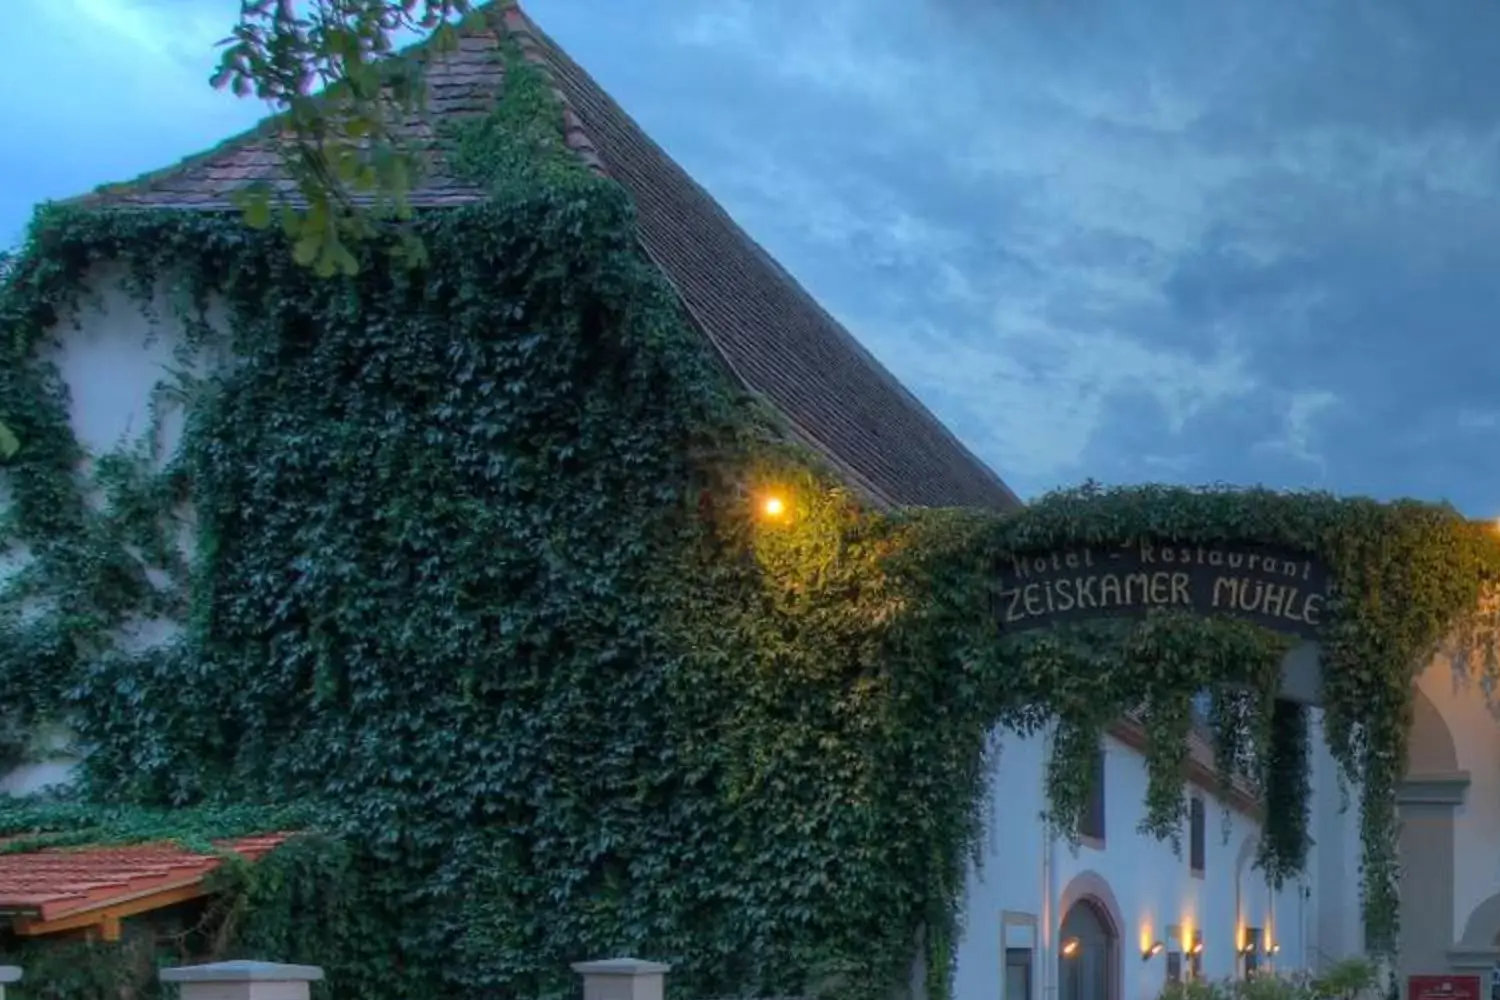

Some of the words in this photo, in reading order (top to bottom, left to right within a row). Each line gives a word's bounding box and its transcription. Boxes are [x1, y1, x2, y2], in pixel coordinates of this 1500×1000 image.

[1012, 547, 1094, 578] Hotel
[1140, 544, 1312, 580] Restaurant
[1212, 574, 1325, 624] MÜHLE
